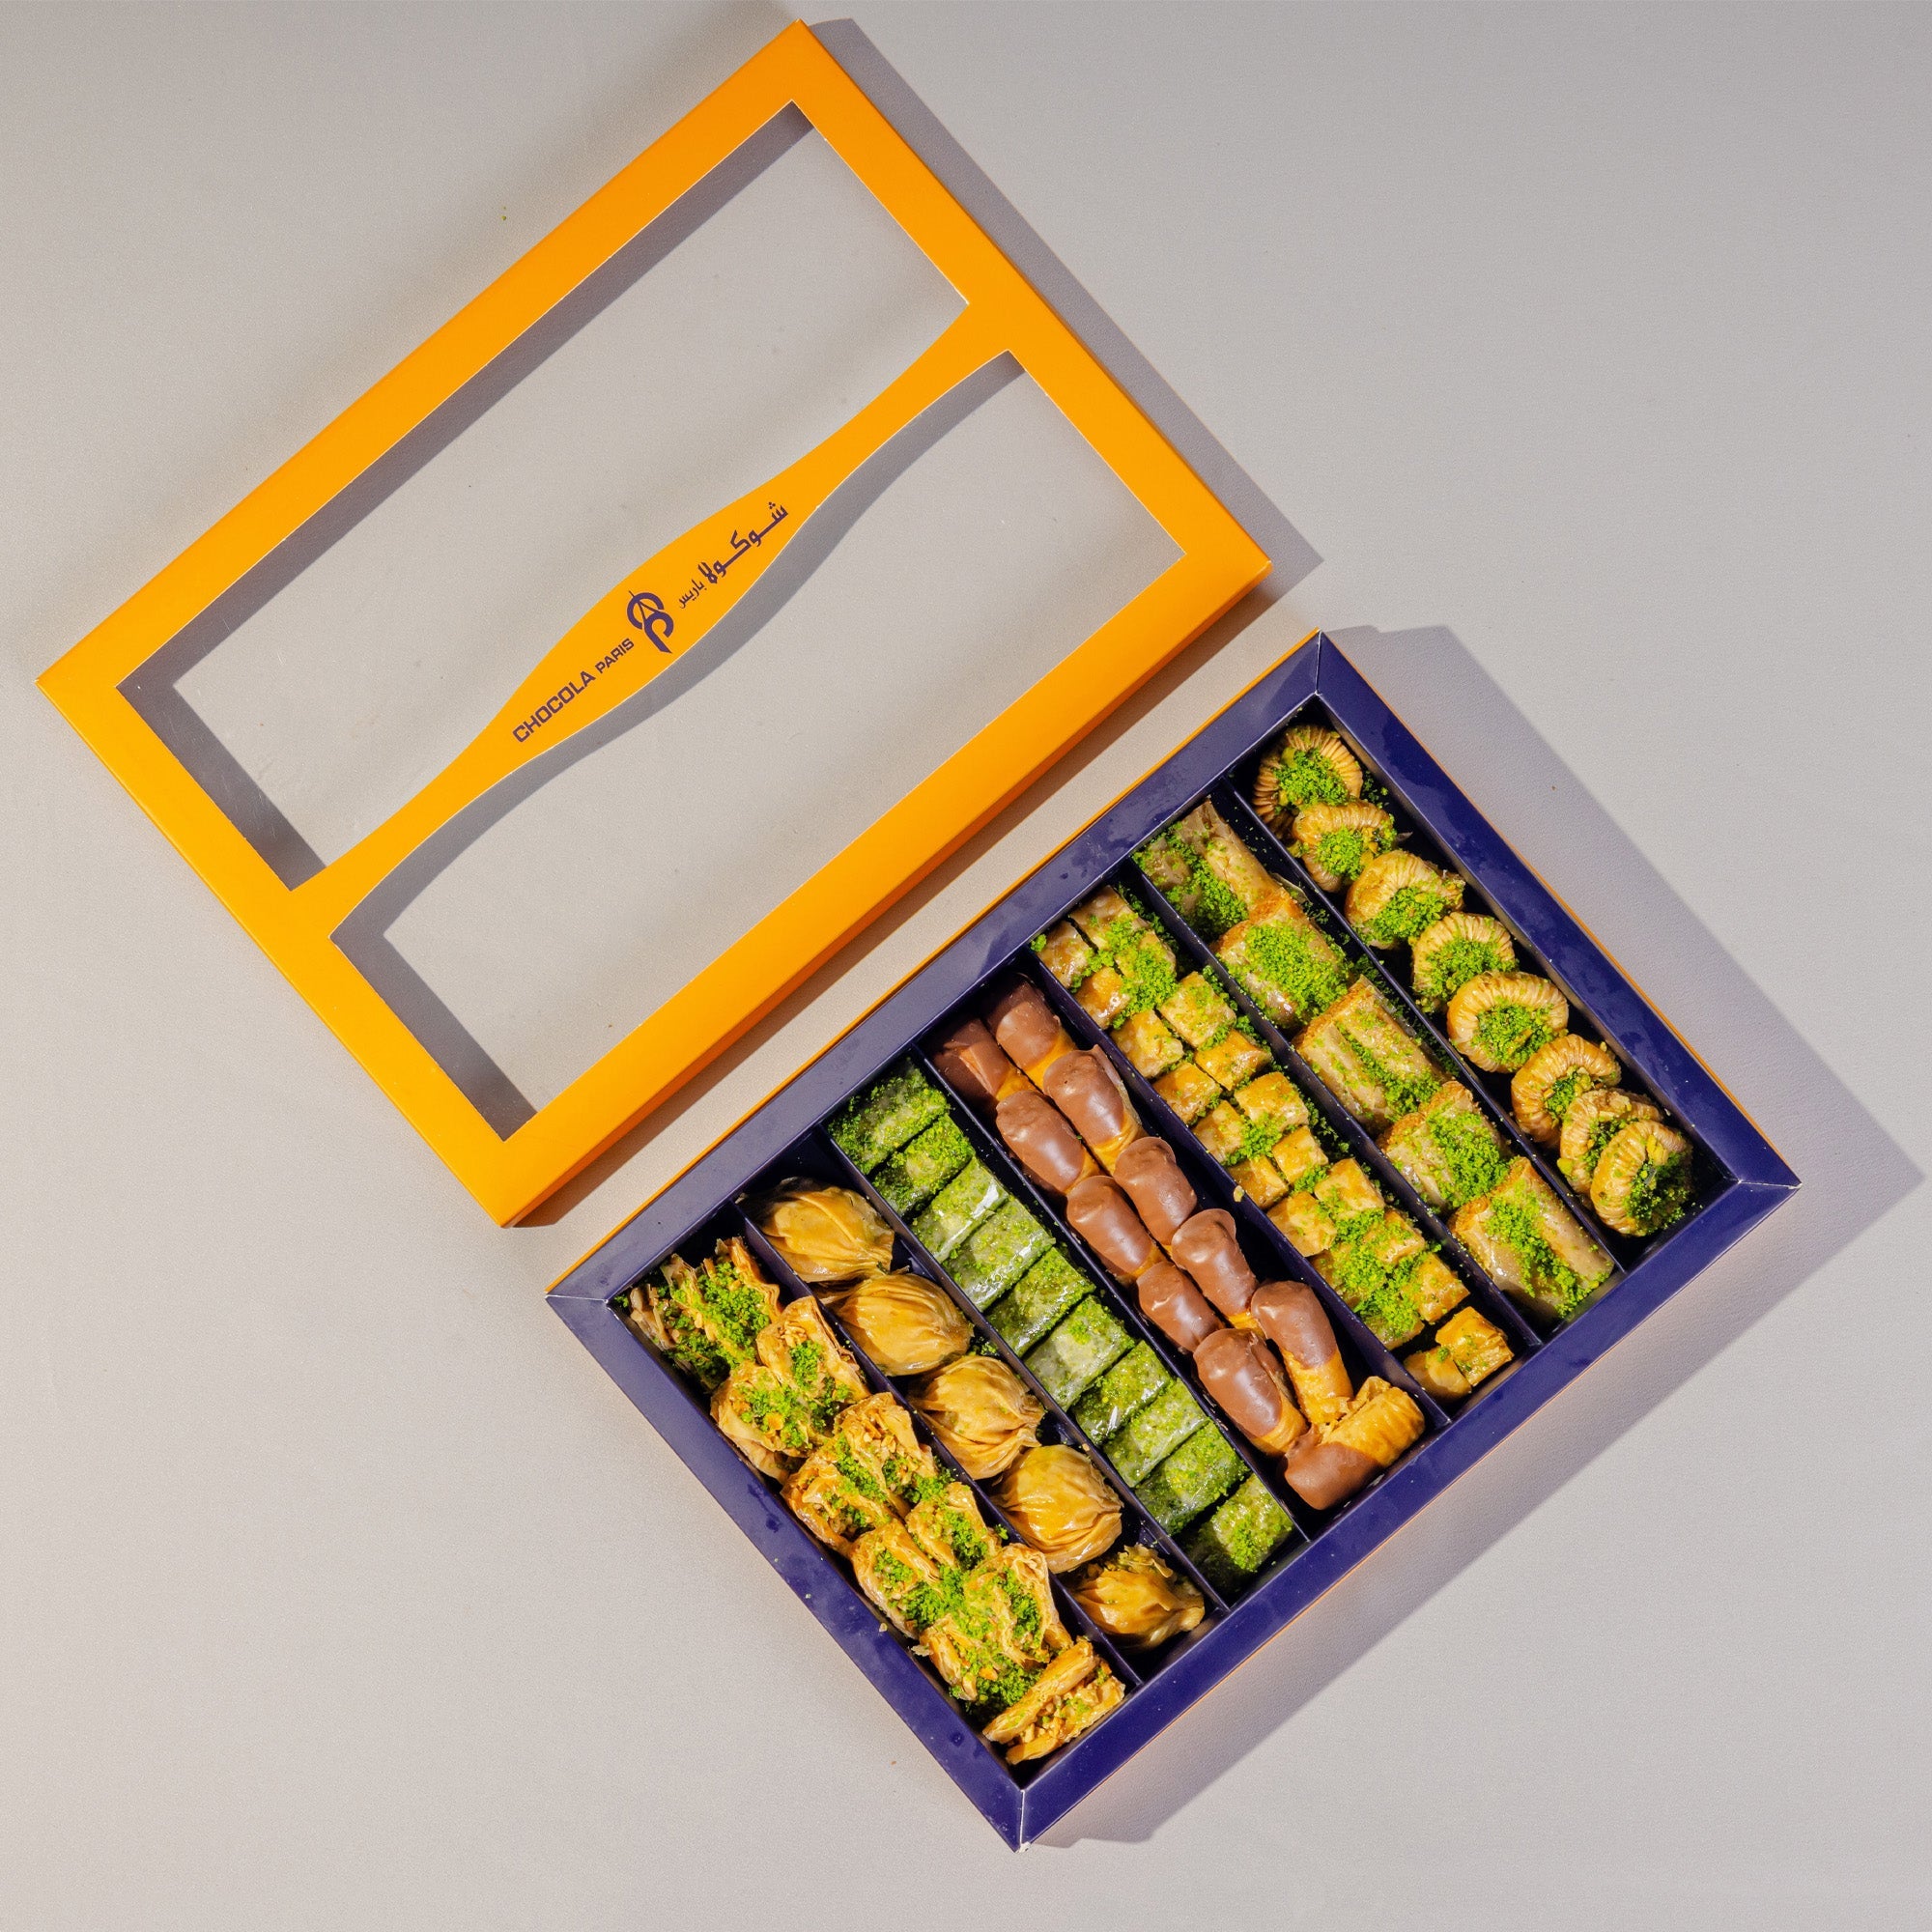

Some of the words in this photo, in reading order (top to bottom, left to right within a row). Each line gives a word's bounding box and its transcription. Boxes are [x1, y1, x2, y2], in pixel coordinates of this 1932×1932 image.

[697, 501, 789, 584] شوكولا
[678, 579, 707, 610] باريس
[512, 670, 596, 743] CHOCOLA
[595, 638, 635, 674] PARIS
